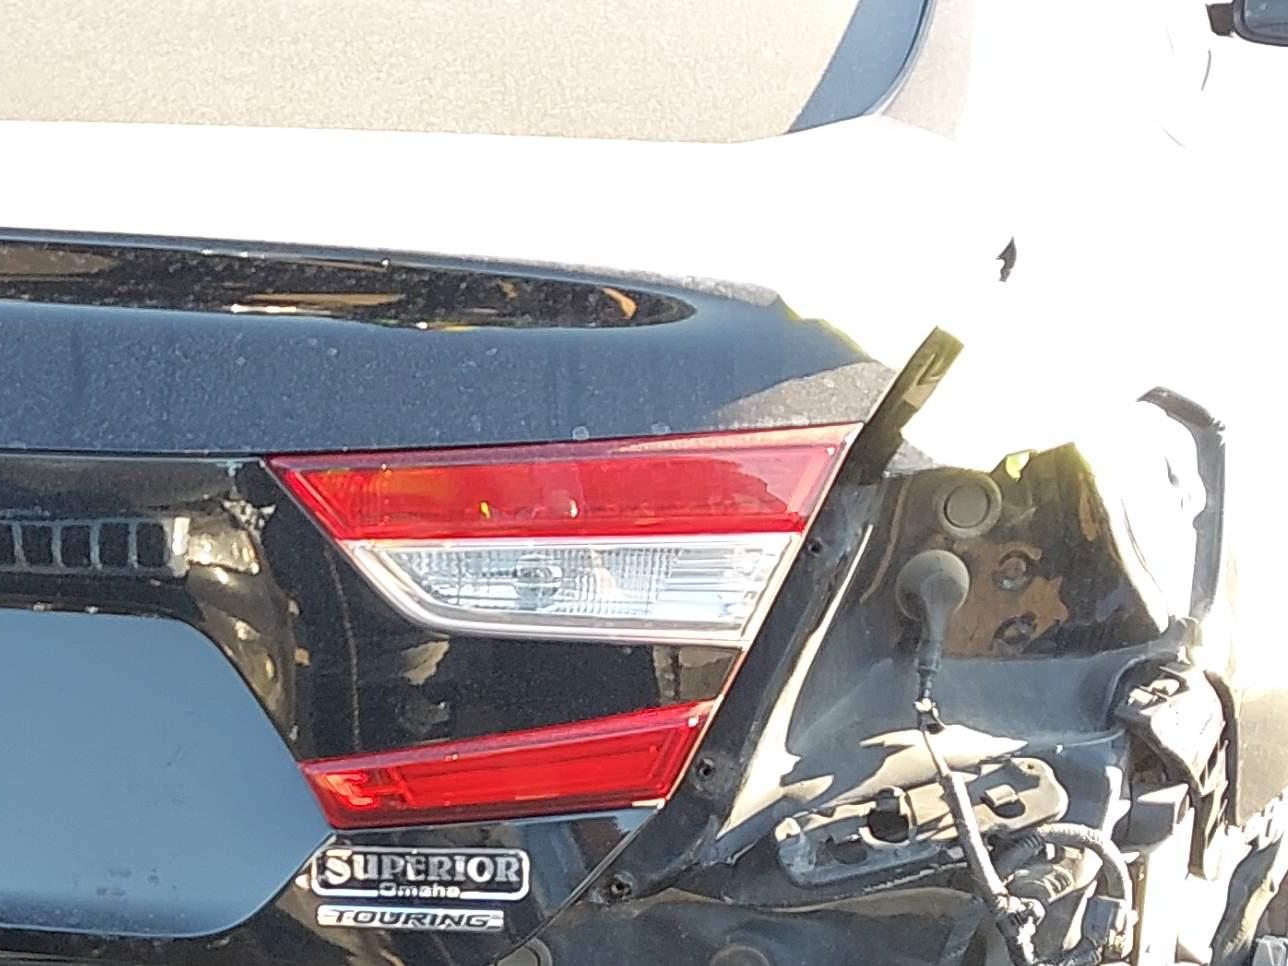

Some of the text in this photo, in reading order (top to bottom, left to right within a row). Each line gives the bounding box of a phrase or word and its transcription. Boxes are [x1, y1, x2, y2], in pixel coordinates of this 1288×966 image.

[325, 850, 521, 885] SUPERIOR
[378, 881, 461, 898] Omaha
[328, 908, 494, 929] TOURING
